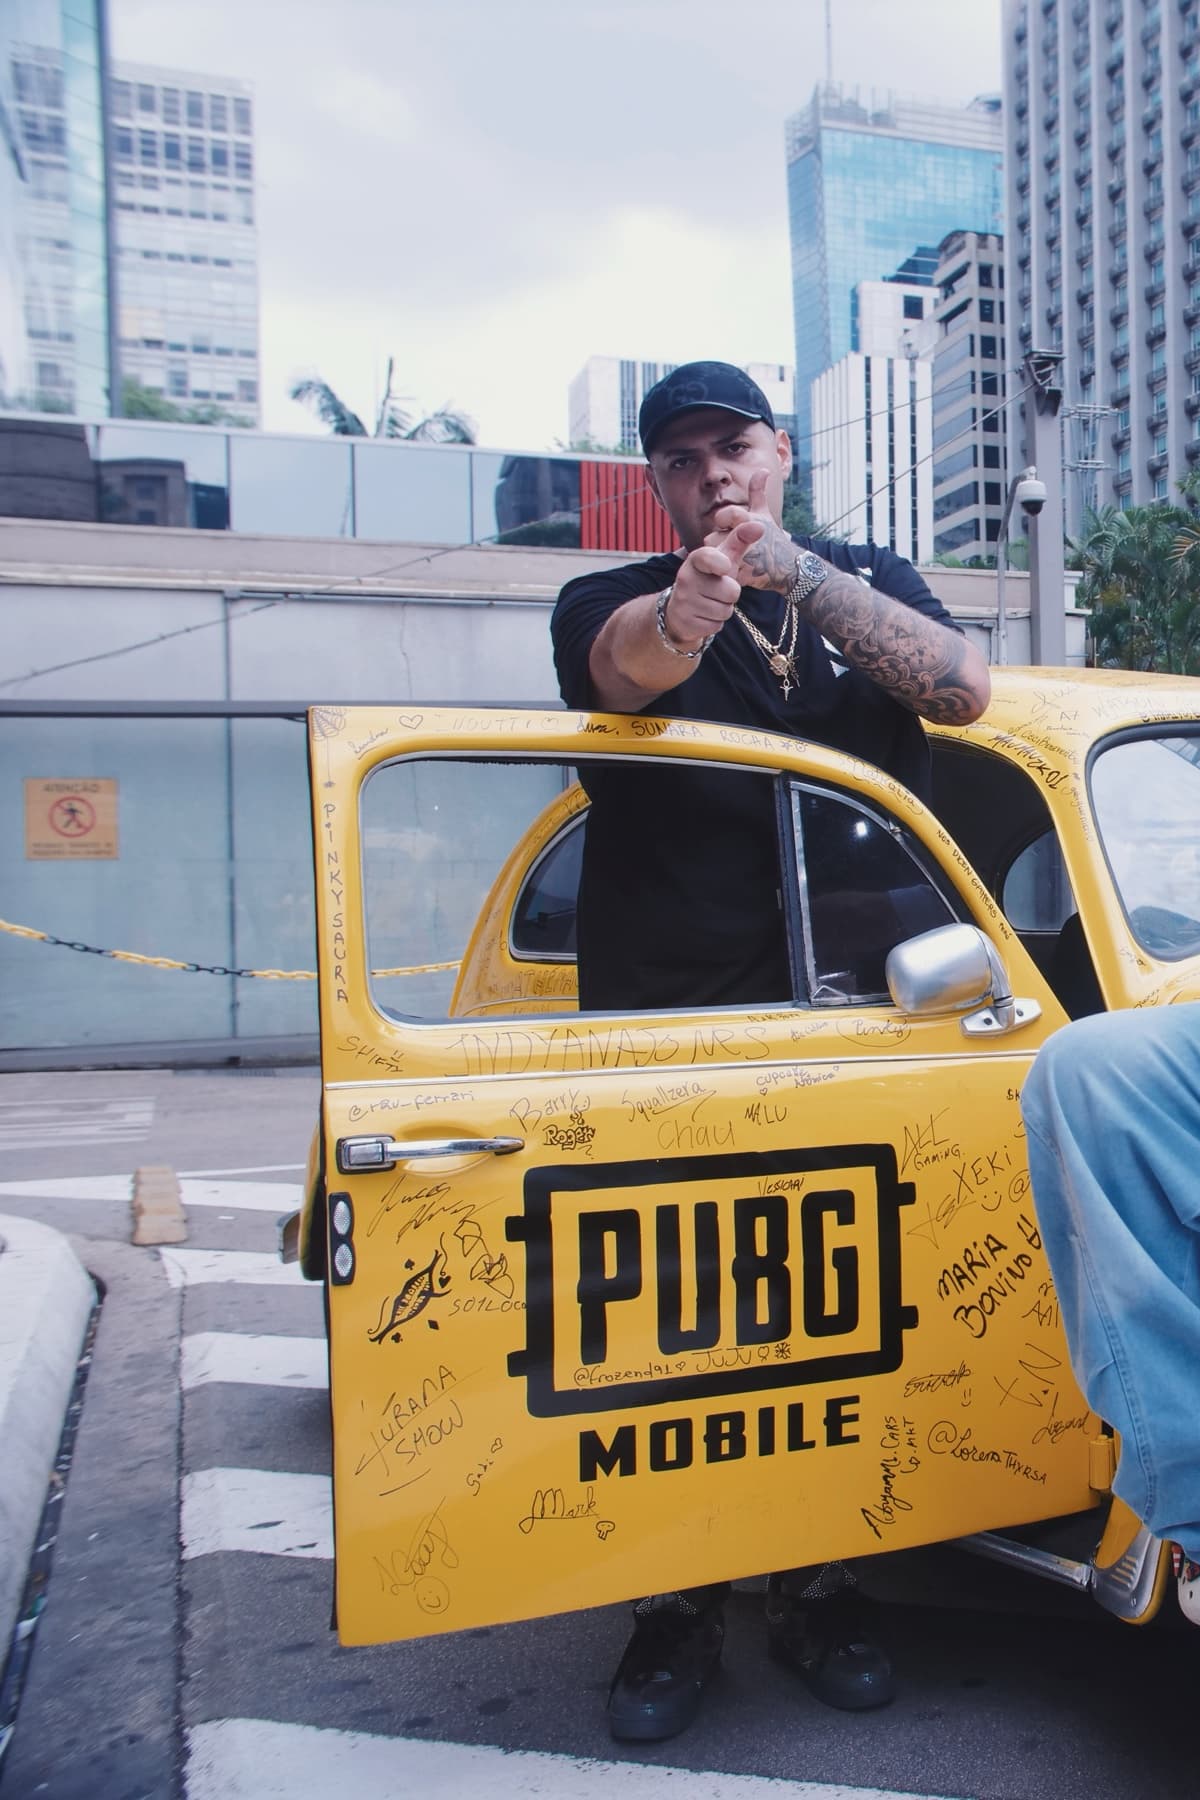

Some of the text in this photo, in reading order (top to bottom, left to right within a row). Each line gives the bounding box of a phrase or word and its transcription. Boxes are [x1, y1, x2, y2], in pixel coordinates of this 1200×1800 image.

[543, 1123, 596, 1151] Roger
[577, 1189, 859, 1366] PUBG
[579, 1395, 861, 1483] MOBILE
[518, 1486, 600, 1534] Mark
